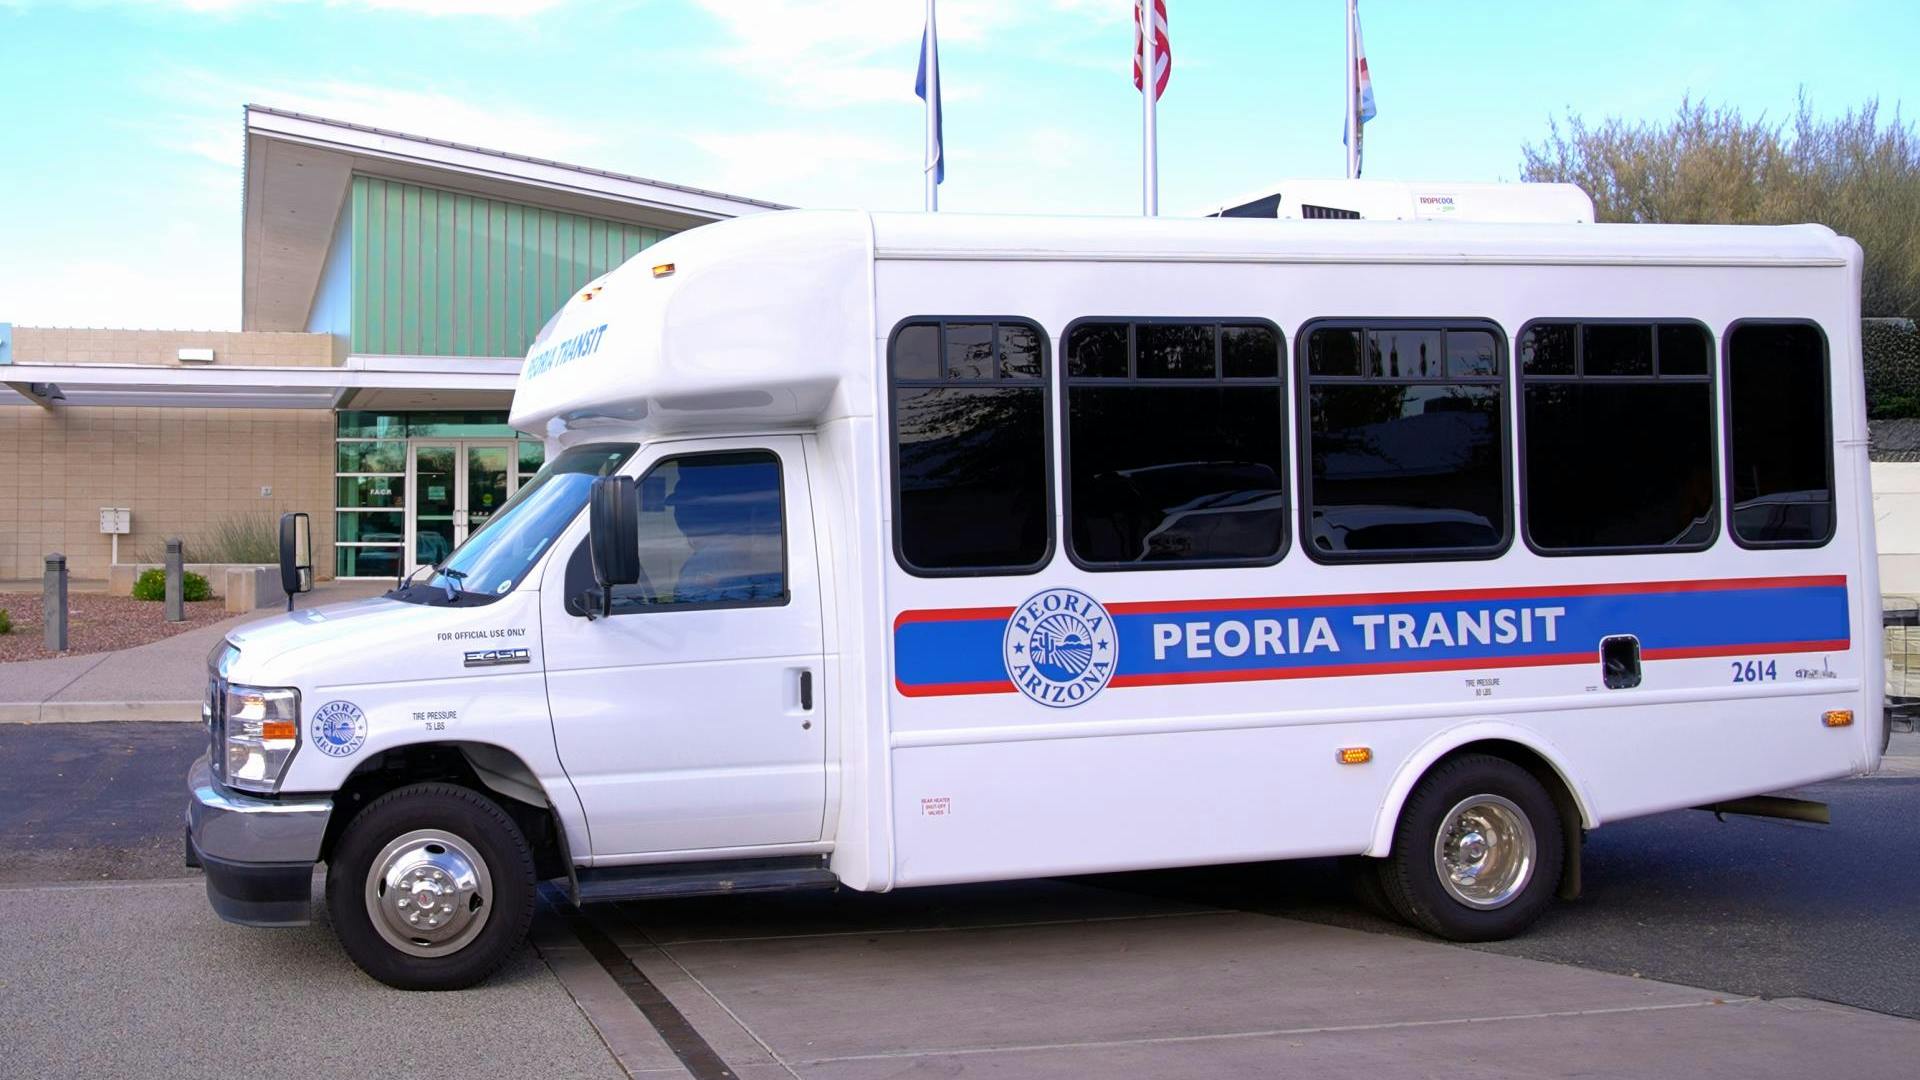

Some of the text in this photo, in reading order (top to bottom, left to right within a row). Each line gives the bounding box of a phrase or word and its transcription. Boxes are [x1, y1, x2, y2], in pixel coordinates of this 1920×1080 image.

[556, 323, 608, 368] TRANSIT
[1015, 594, 1103, 634] PEORIA
[437, 628, 526, 641] FOR OFFICIAL USE ONLY
[1153, 607, 1566, 660] PEORIA TRANSIT
[1731, 659, 1777, 682] 2614
[1013, 662, 1109, 703] ARIZONA
[316, 703, 361, 722] PEORIA
[412, 710, 457, 720] TIRE PRESSURE
[425, 721, 445, 730] 75 LBS
[315, 735, 364, 755] ARIZONA
